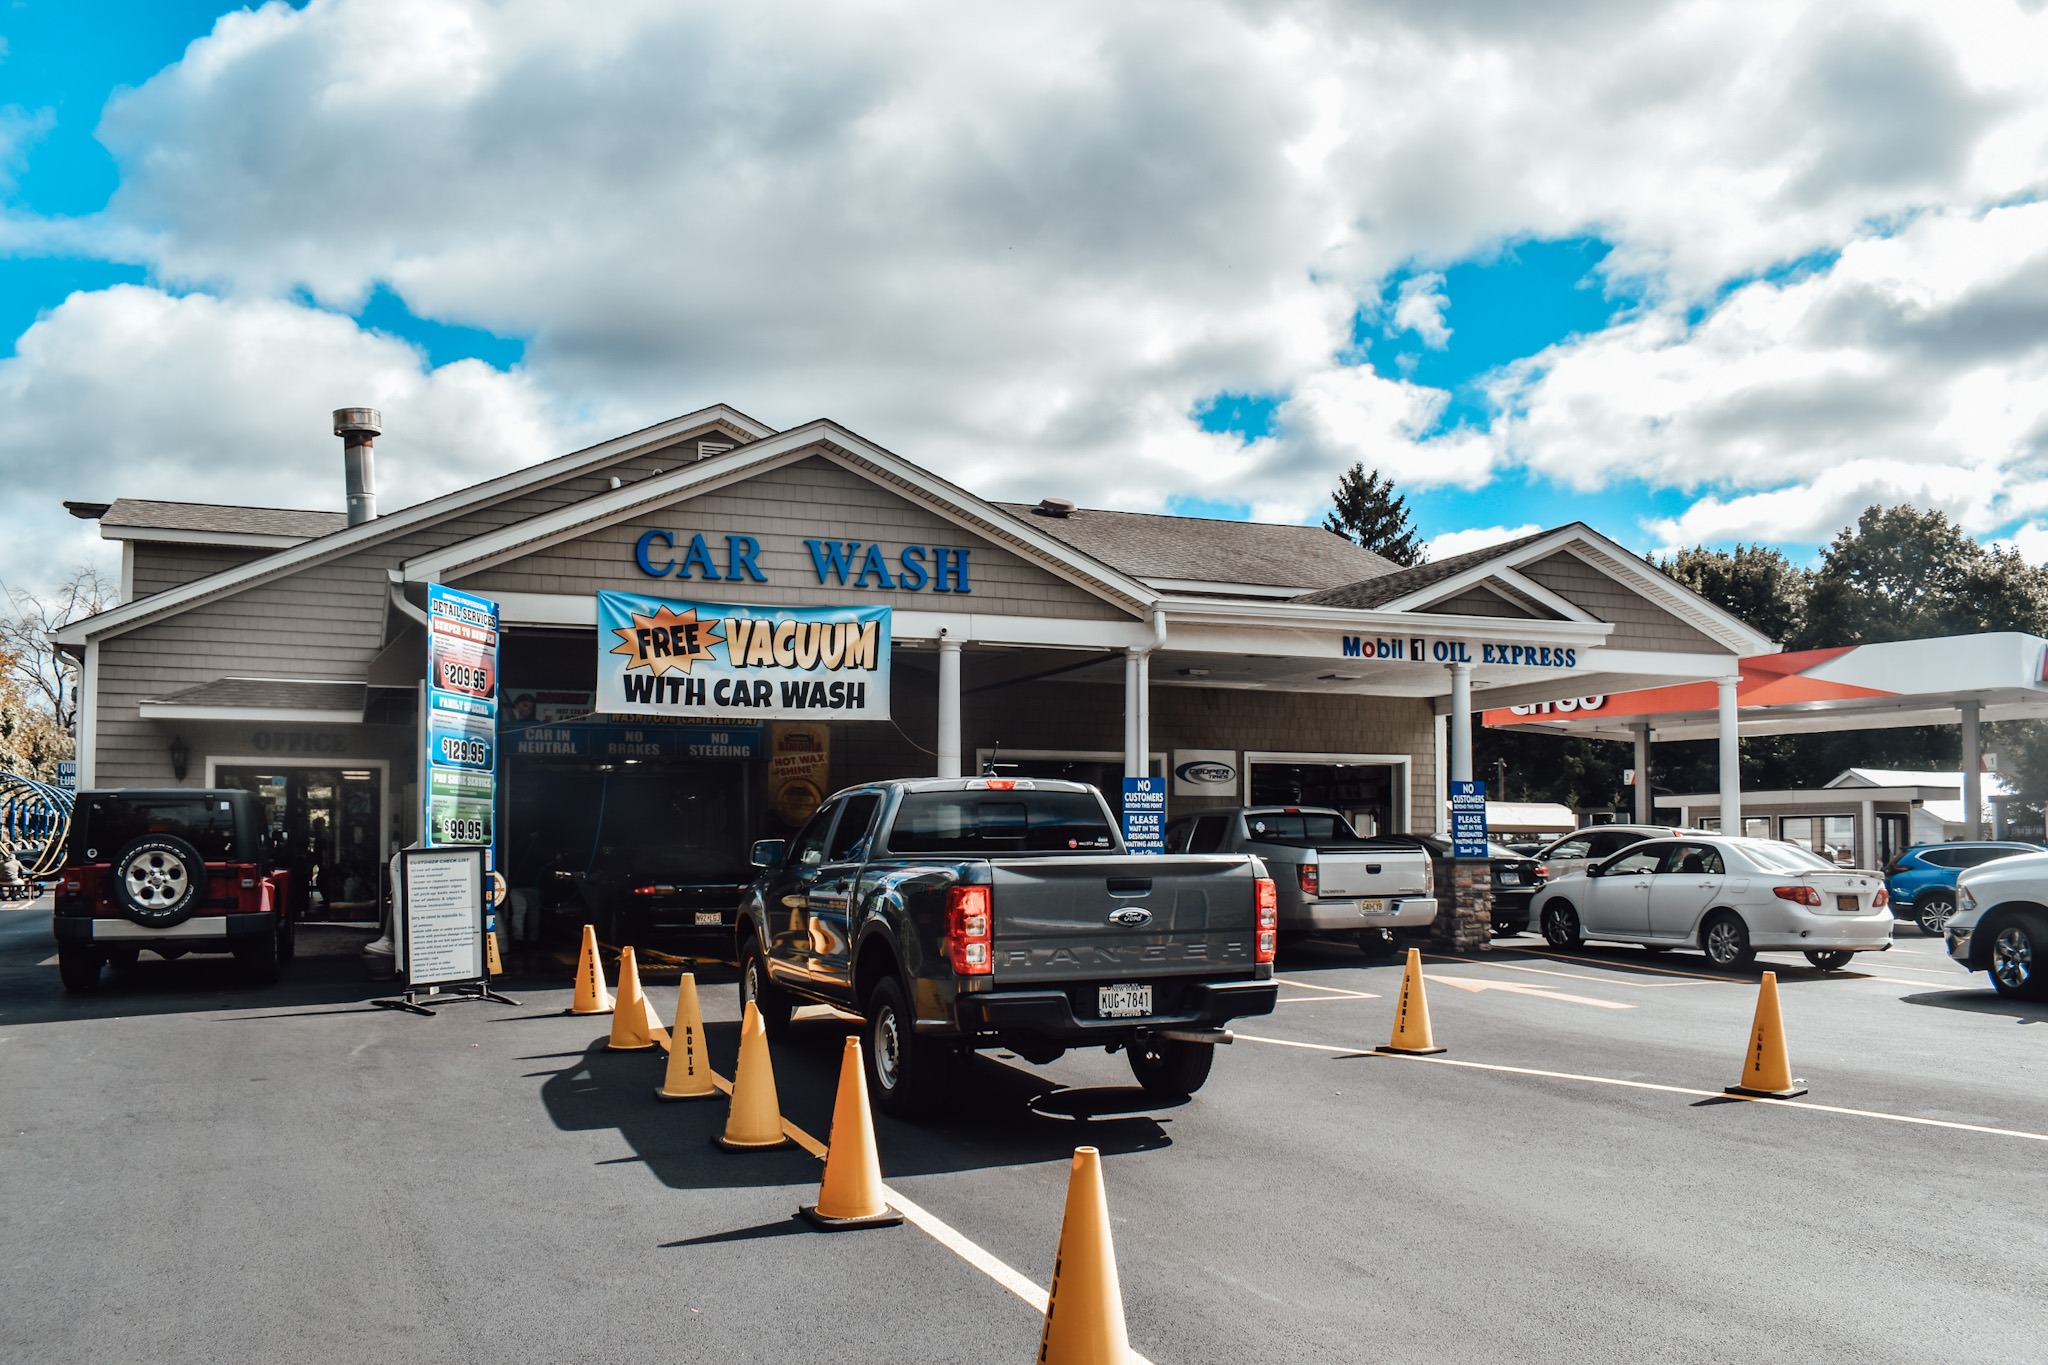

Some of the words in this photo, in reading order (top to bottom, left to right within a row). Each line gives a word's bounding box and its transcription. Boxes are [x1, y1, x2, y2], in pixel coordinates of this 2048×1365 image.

[635, 529, 768, 582] CAR
[803, 539, 972, 593] WASH
[433, 599, 461, 618] DETAIL
[462, 608, 496, 628] SERVICES
[636, 623, 702, 660] FREE
[724, 618, 880, 671] VACUUM
[1342, 636, 1403, 658] Mobil
[1412, 639, 1425, 661] 1
[1433, 640, 1472, 663] OIL
[1482, 643, 1576, 668] EXPRESS
[444, 663, 487, 690] $209.95
[623, 674, 706, 706] WITH
[713, 678, 773, 708] CAR
[780, 681, 866, 709] WASH
[464, 701, 489, 715] SPECIAL
[253, 732, 347, 752] OFFICE
[525, 729, 553, 741] CAR
[556, 730, 570, 741] IN
[625, 731, 644, 742] NO
[711, 733, 729, 744] NO
[443, 739, 484, 763] $129.95
[518, 742, 577, 754] NEUTRAL
[608, 743, 660, 755] BRAKES
[689, 744, 751, 757] STEERING
[774, 756, 796, 767] HOT
[798, 753, 825, 765] WAX
[780, 766, 812, 777] SHINE
[433, 773, 447, 783] PRO
[447, 774, 467, 785] SHINE
[467, 775, 491, 787] SERVICE
[1137, 780, 1151, 792] NO
[1462, 783, 1474, 794] NO
[1124, 792, 1164, 802] CUSTOMERS
[1453, 795, 1485, 804] CUSTOMERS
[1129, 815, 1159, 824] PLEASE
[1458, 816, 1481, 824] PLEASE
[444, 819, 481, 840] $99.95
[1123, 912, 1142, 923] Ford
[1003, 943, 1247, 966] RANGER
[1400, 974, 1410, 1033] SIMONIZ
[686, 1026, 694, 1075] MONIZ
